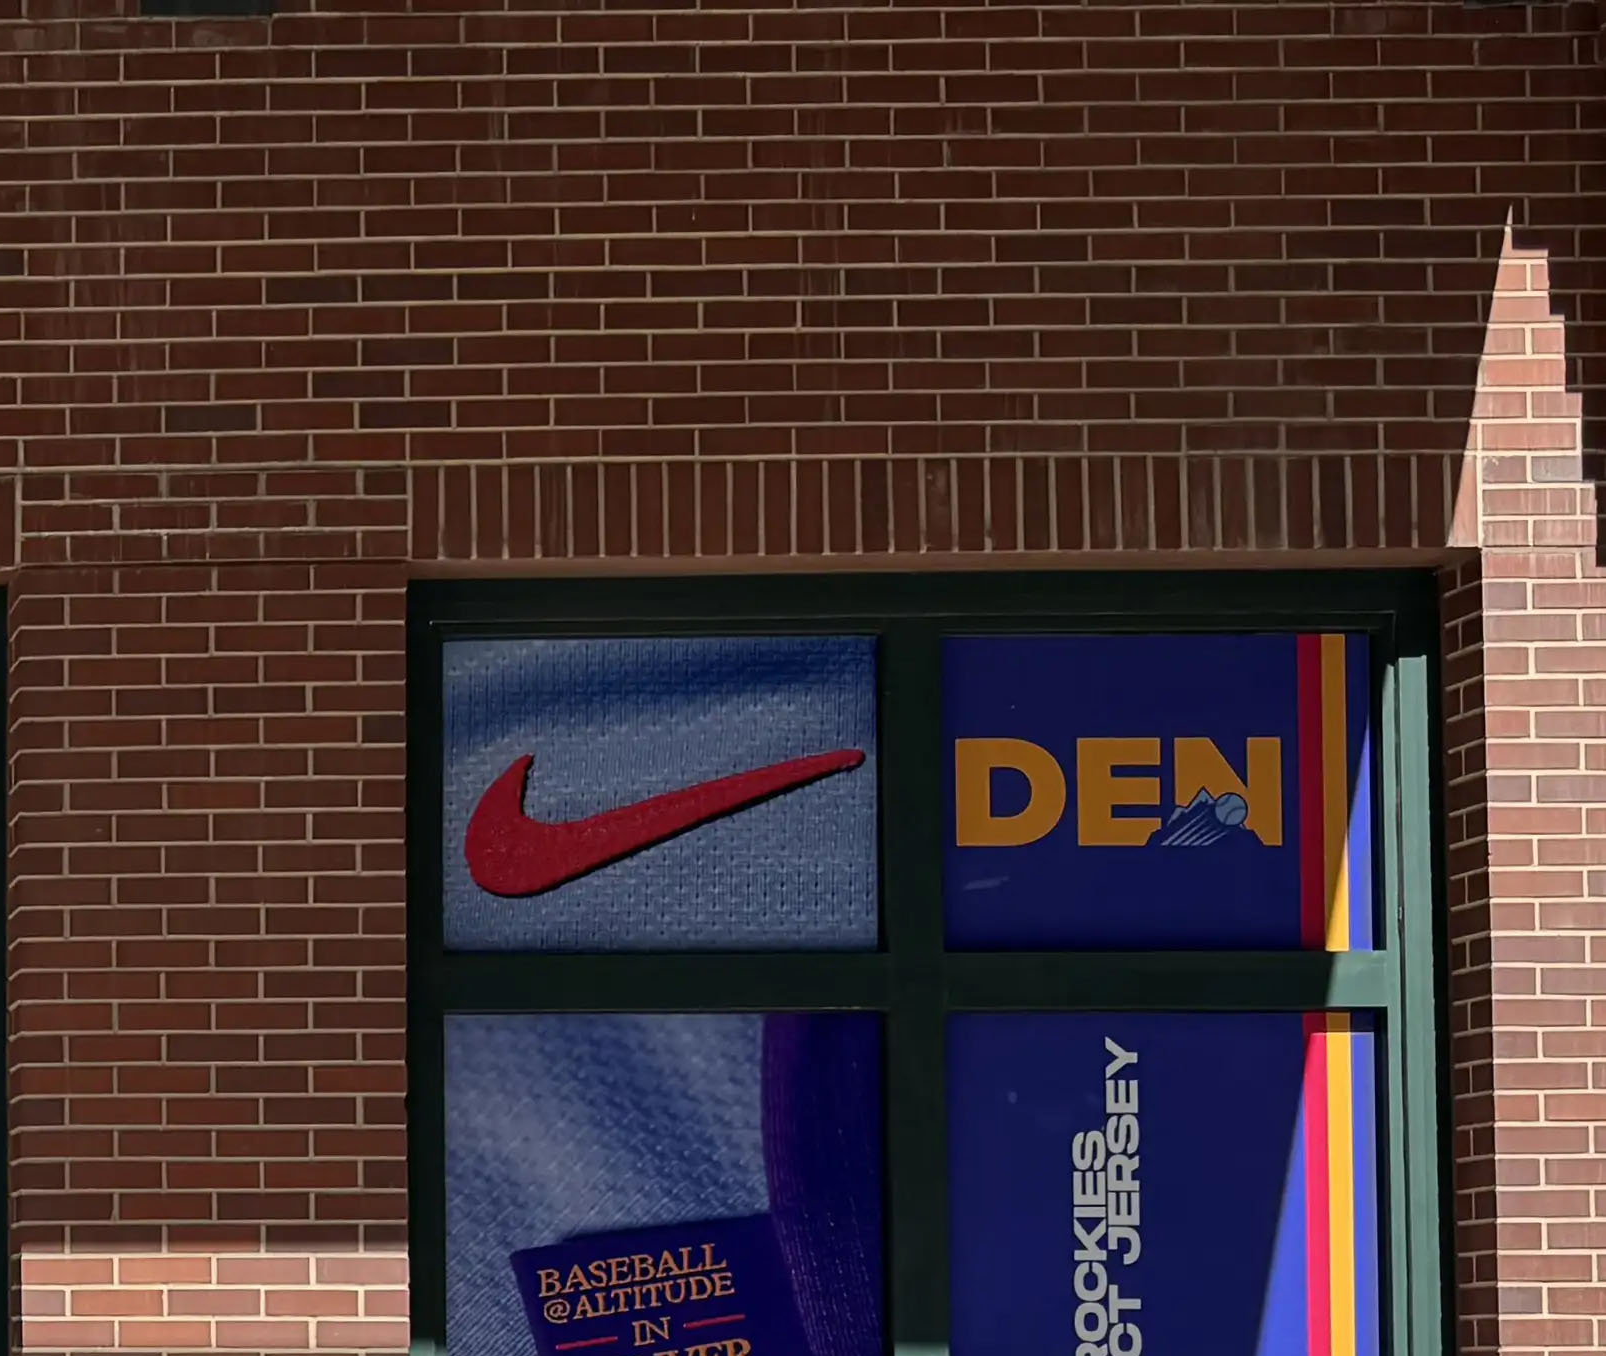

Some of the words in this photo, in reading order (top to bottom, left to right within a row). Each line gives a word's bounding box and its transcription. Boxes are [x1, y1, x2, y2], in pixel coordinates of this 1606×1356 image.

[954, 737, 1283, 847] DEN
[1105, 1036, 1141, 1265] JERSEY
[538, 1243, 727, 1297] BASEBALL
[543, 1272, 736, 1324] @ALTITUDE
[632, 1317, 672, 1347] IN
